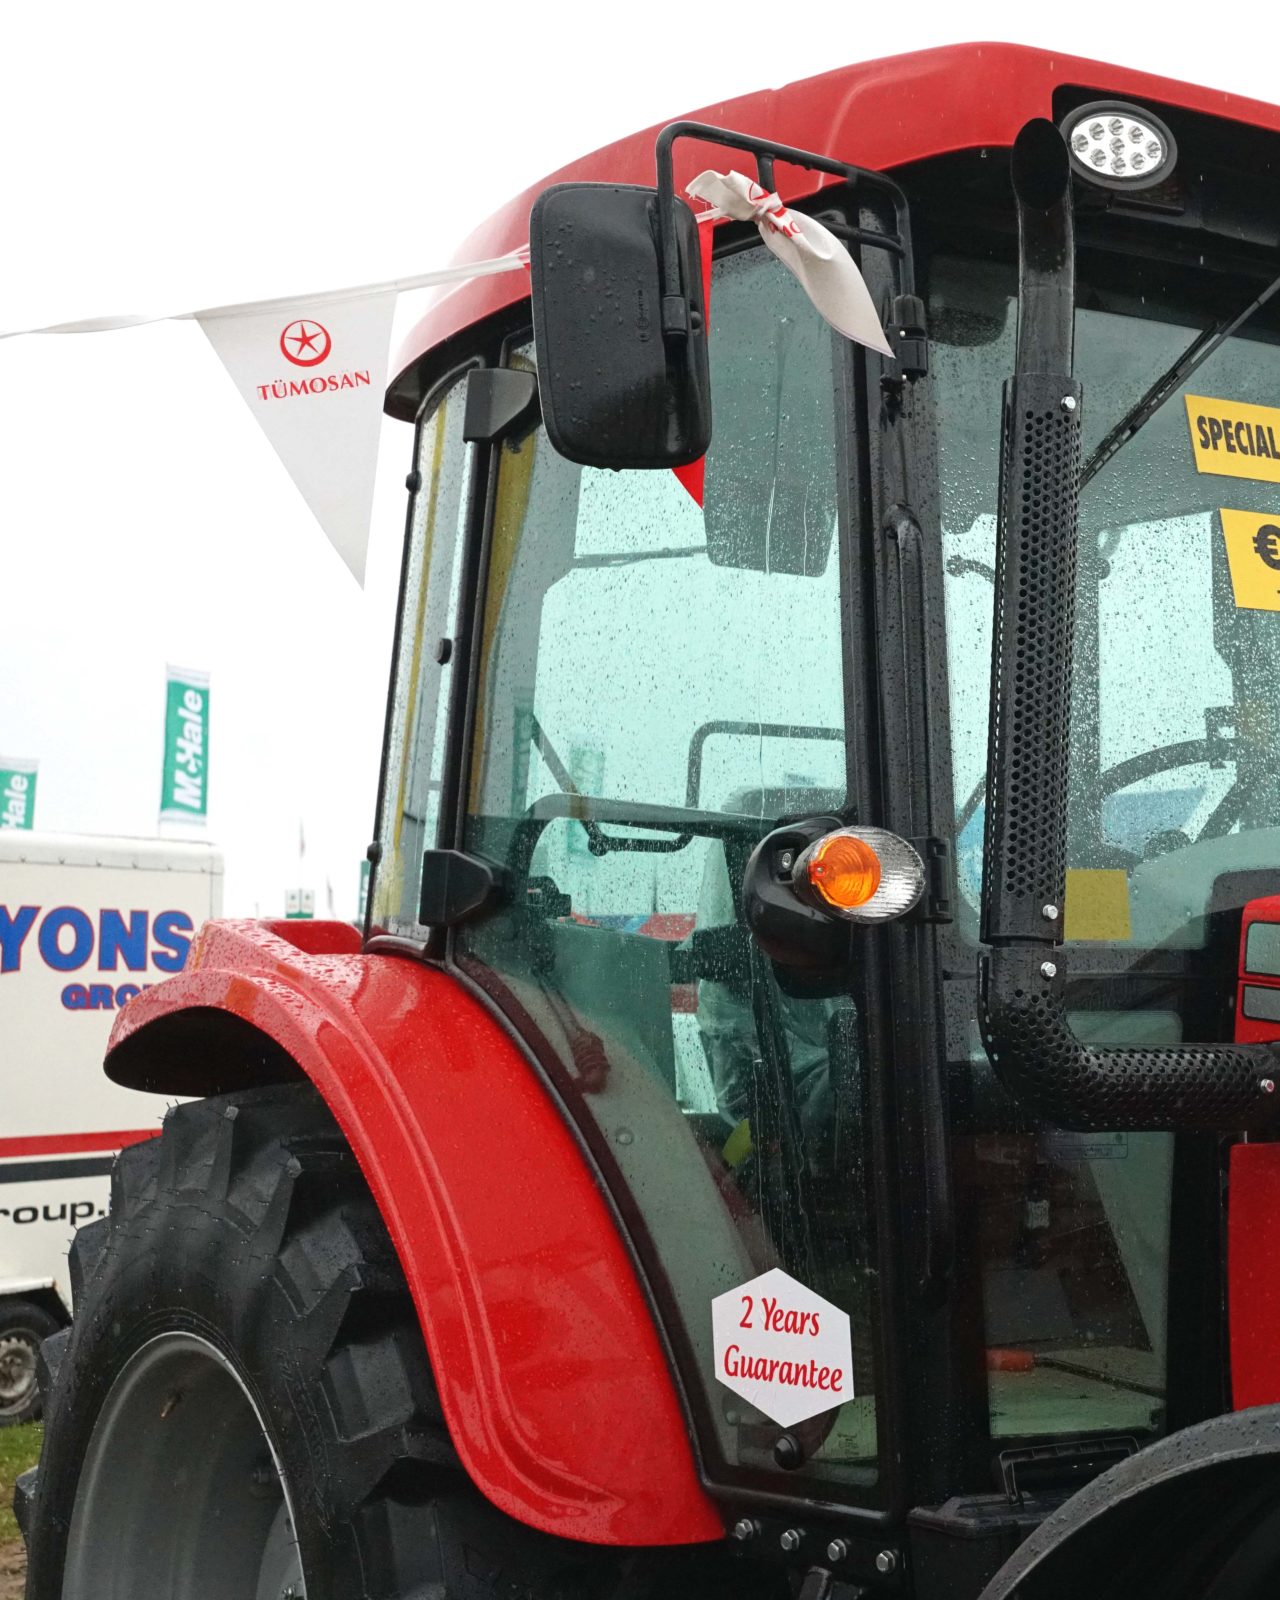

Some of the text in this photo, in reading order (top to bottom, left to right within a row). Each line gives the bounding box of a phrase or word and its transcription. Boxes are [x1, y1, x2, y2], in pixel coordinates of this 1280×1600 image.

[257, 370, 371, 401] TÜMOSAN
[1197, 415, 1280, 461] SPECIAL
[172, 688, 203, 809] McHale
[61, 983, 151, 1011] GRO
[739, 1295, 820, 1337] 2 Years
[723, 1344, 843, 1392] Guarantee
